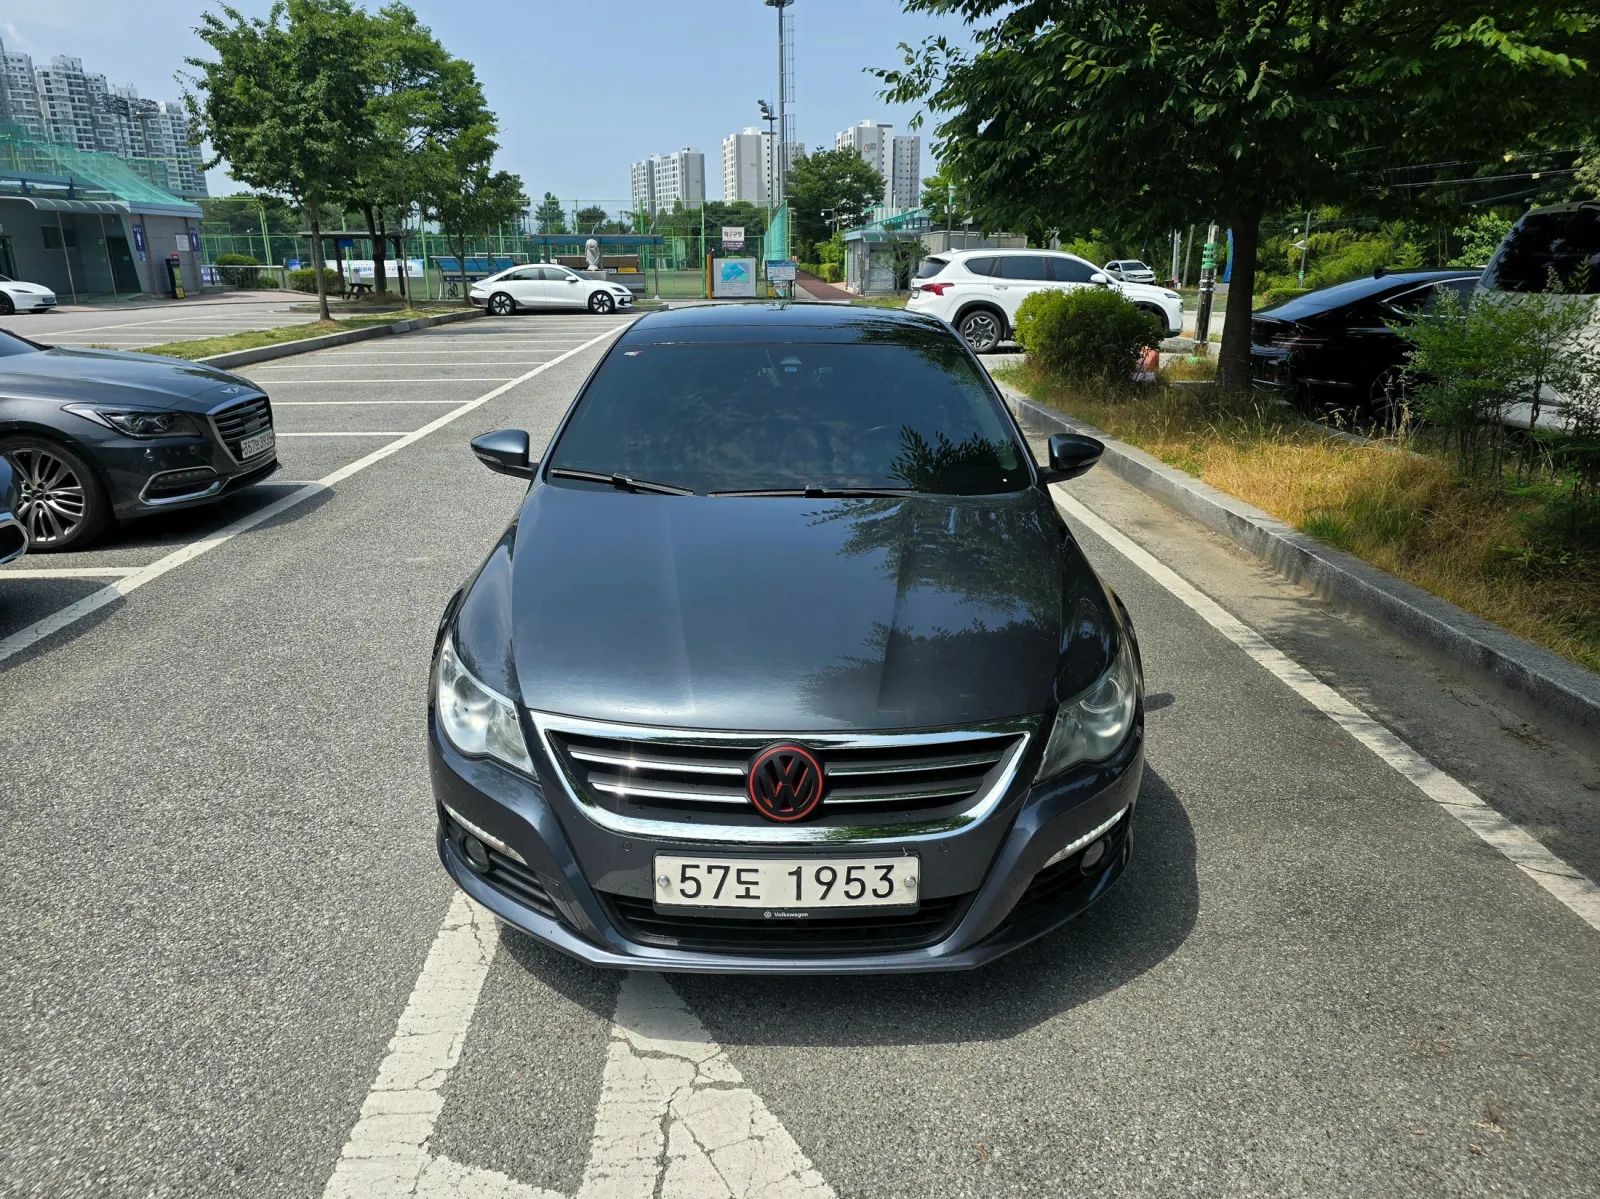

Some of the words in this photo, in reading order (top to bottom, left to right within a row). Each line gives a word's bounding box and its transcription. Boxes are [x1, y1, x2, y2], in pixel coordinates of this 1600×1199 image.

[679, 864, 761, 900] 57도
[787, 865, 895, 901] 1953
[774, 911, 808, 919] Volkswagen
